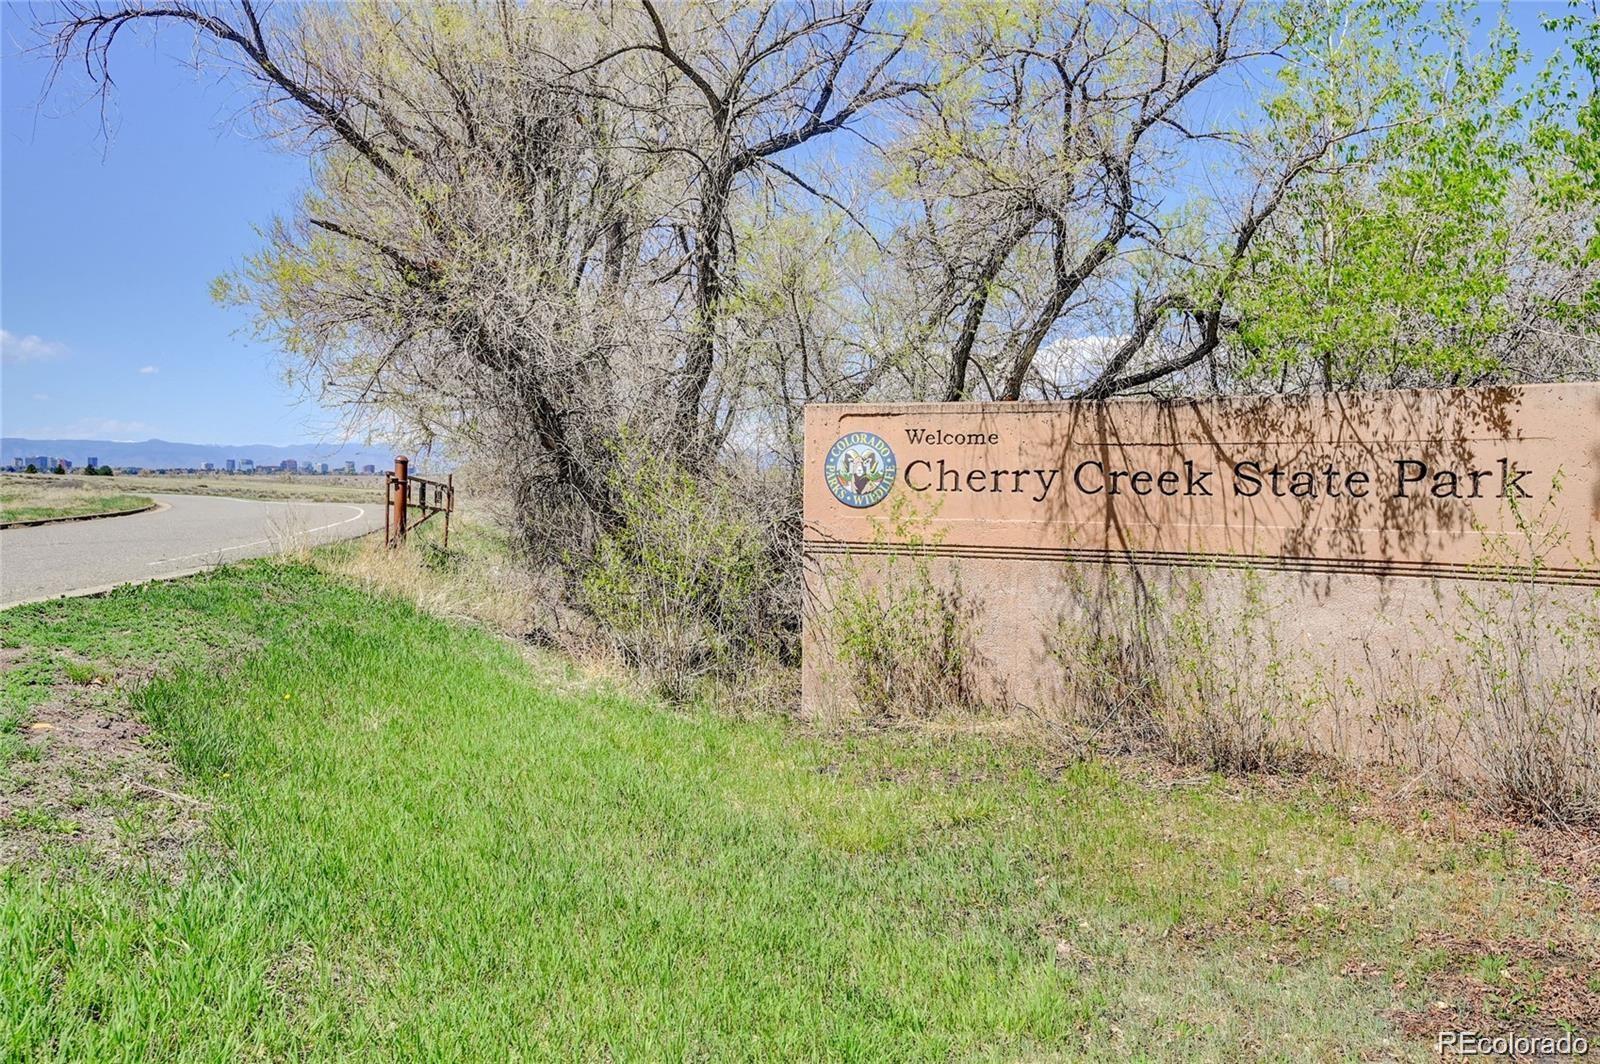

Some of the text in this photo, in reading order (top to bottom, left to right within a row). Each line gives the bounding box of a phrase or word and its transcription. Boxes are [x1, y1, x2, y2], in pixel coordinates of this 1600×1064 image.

[831, 433, 890, 457] COLORADO
[905, 429, 999, 445] Welcome
[826, 464, 847, 499] PARKS
[904, 457, 1533, 502] Cherry Creek State Park
